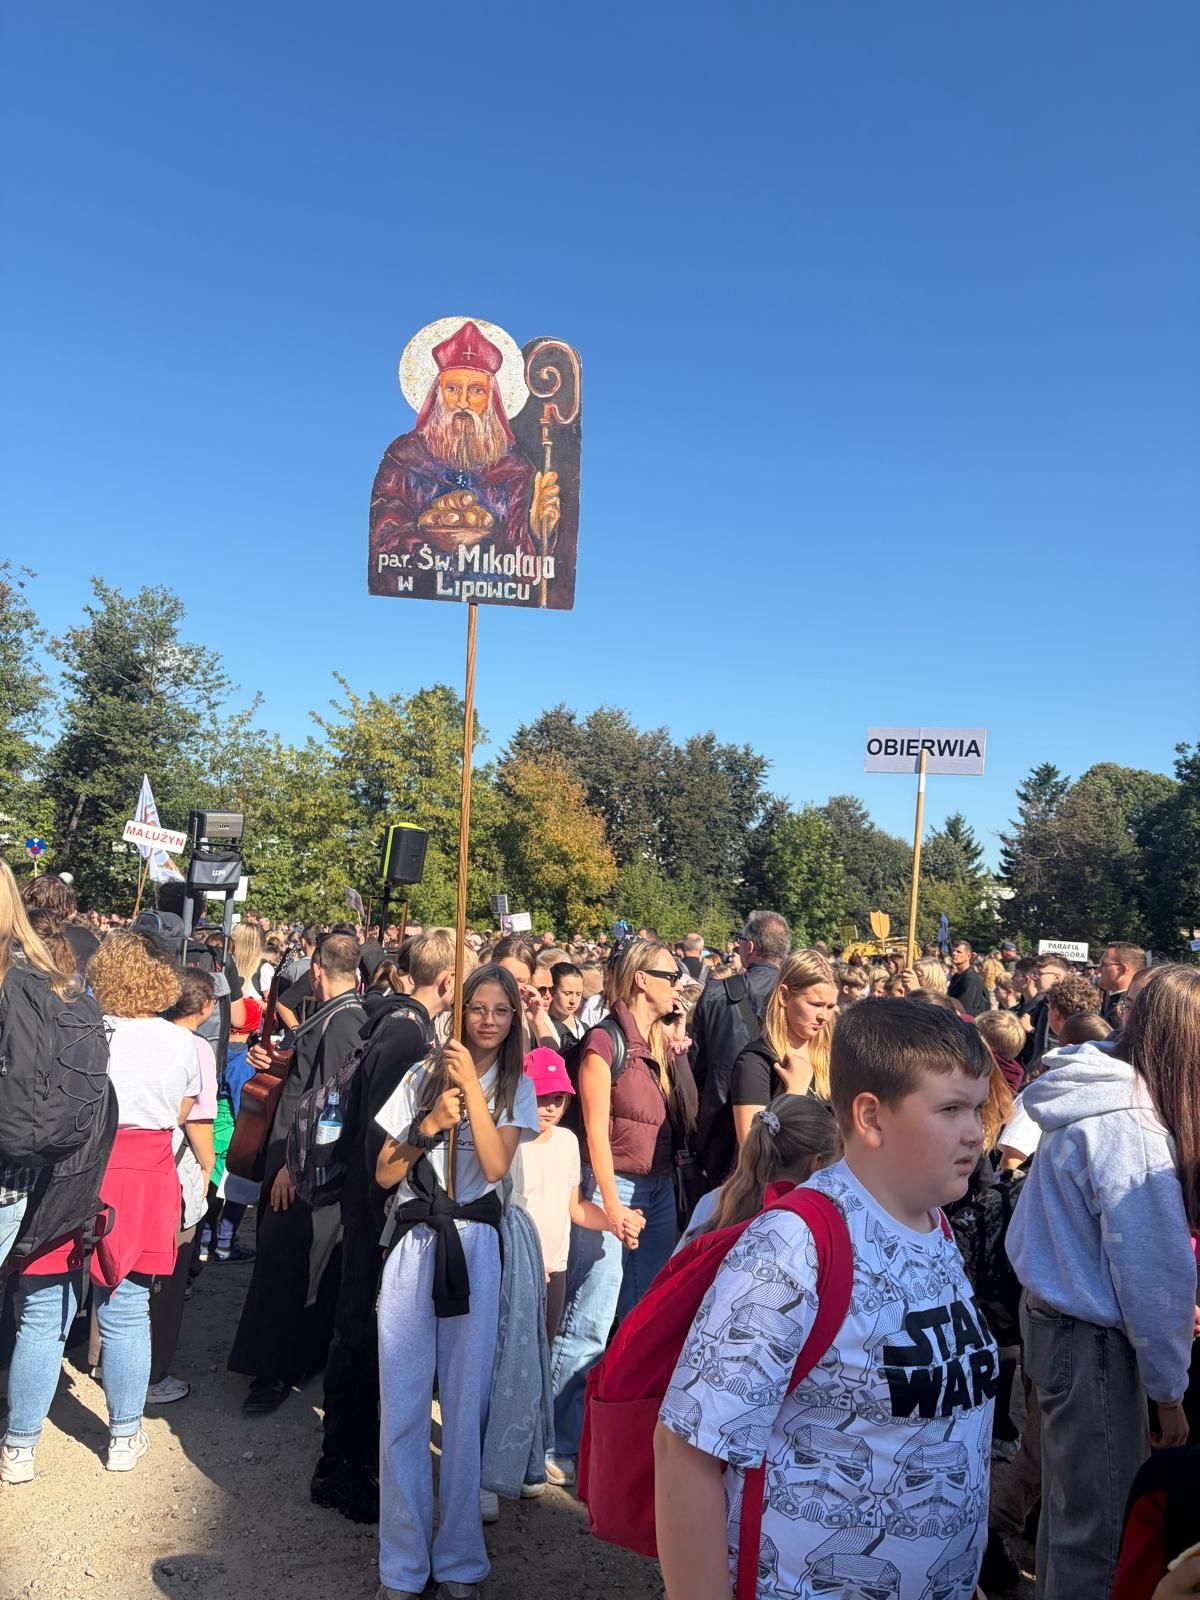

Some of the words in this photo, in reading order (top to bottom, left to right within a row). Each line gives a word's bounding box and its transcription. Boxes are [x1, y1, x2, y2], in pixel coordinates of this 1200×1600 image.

[378, 552, 412, 573] par.
[458, 544, 556, 586] Mikołaja
[436, 571, 530, 602] Lipowcu
[866, 738, 981, 758] OBIERWIA
[126, 825, 185, 847] MALUŻYN
[1048, 942, 1079, 950] PARAFIA
